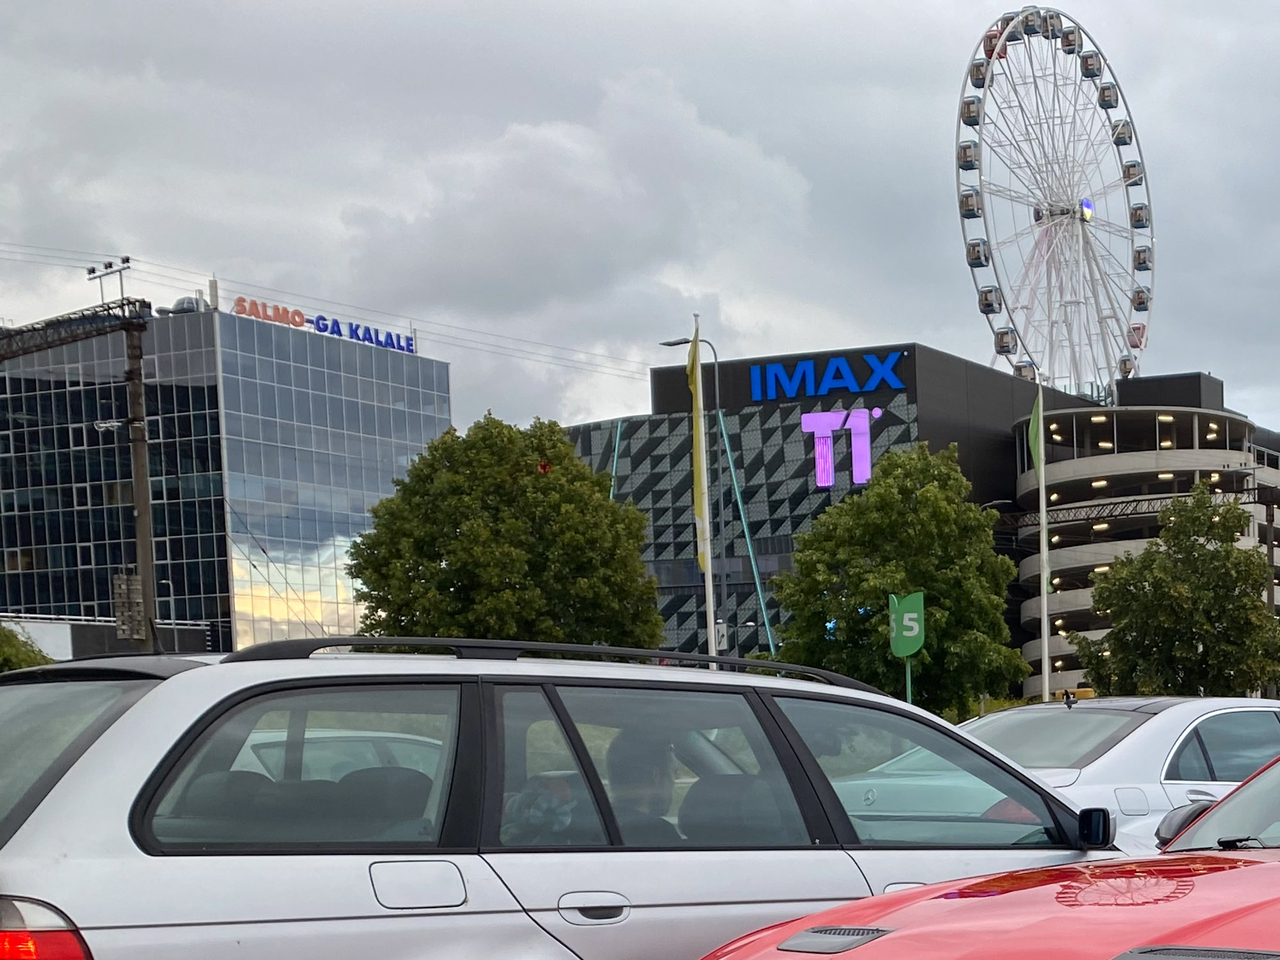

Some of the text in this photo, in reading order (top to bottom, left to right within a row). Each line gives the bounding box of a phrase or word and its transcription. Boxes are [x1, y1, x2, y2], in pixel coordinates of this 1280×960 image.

[235, 296, 415, 353] SALMO-GA KALALE
[750, 351, 906, 401] IMAX
[801, 408, 872, 487] T1
[903, 613, 920, 637] 5
